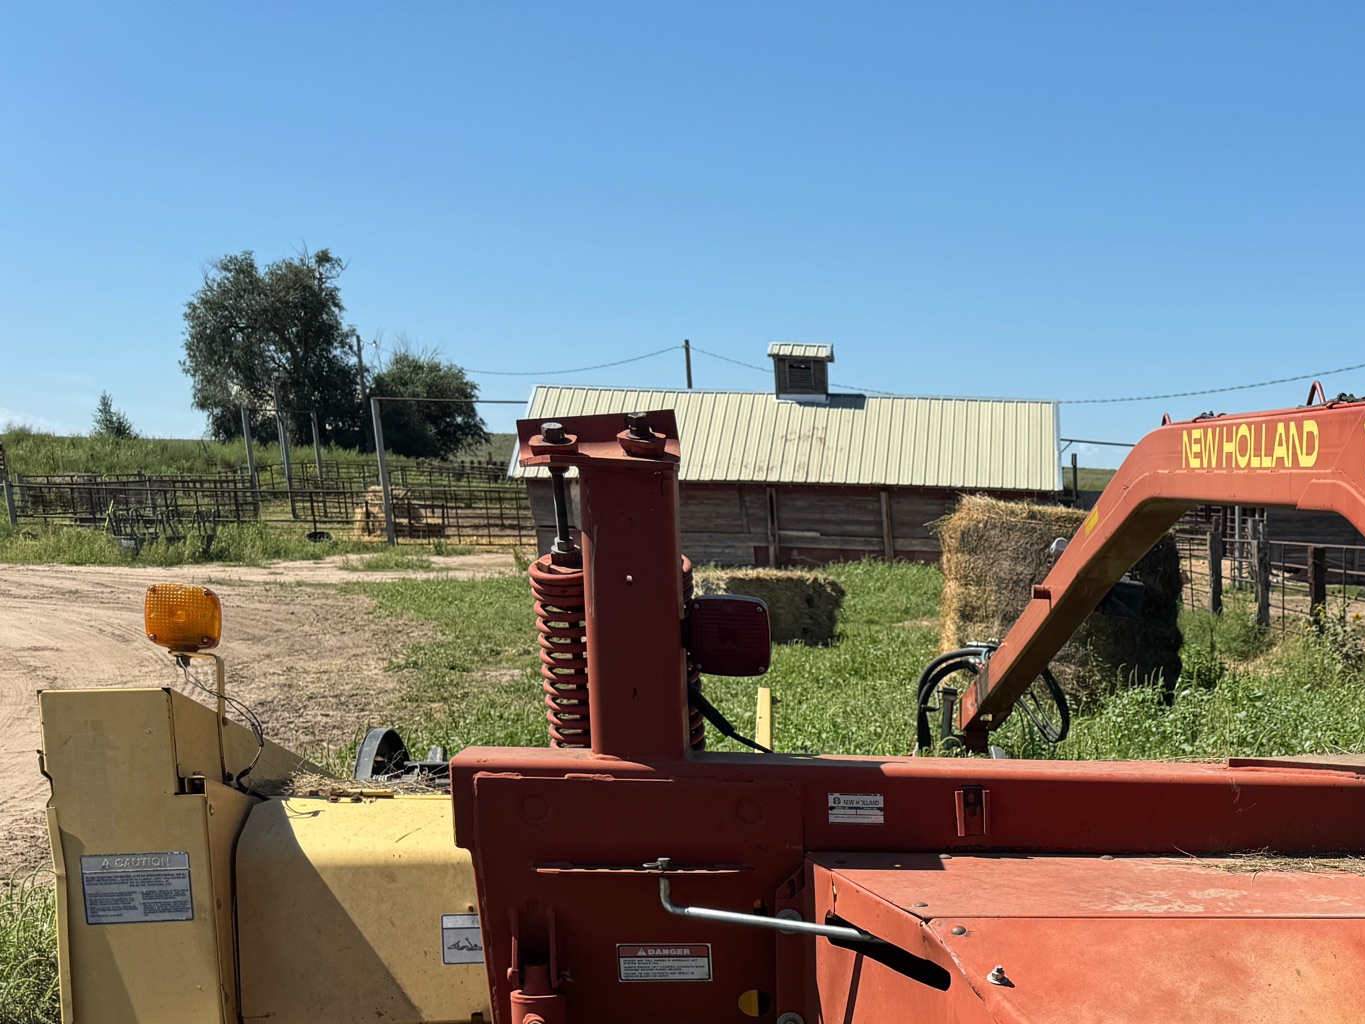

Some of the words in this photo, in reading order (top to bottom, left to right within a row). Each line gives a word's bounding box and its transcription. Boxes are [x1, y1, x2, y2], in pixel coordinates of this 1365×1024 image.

[1182, 427, 1220, 469] NEW
[1223, 419, 1319, 468] HOLLAND
[115, 857, 170, 868] CAUTION
[647, 948, 691, 956] DANGER
